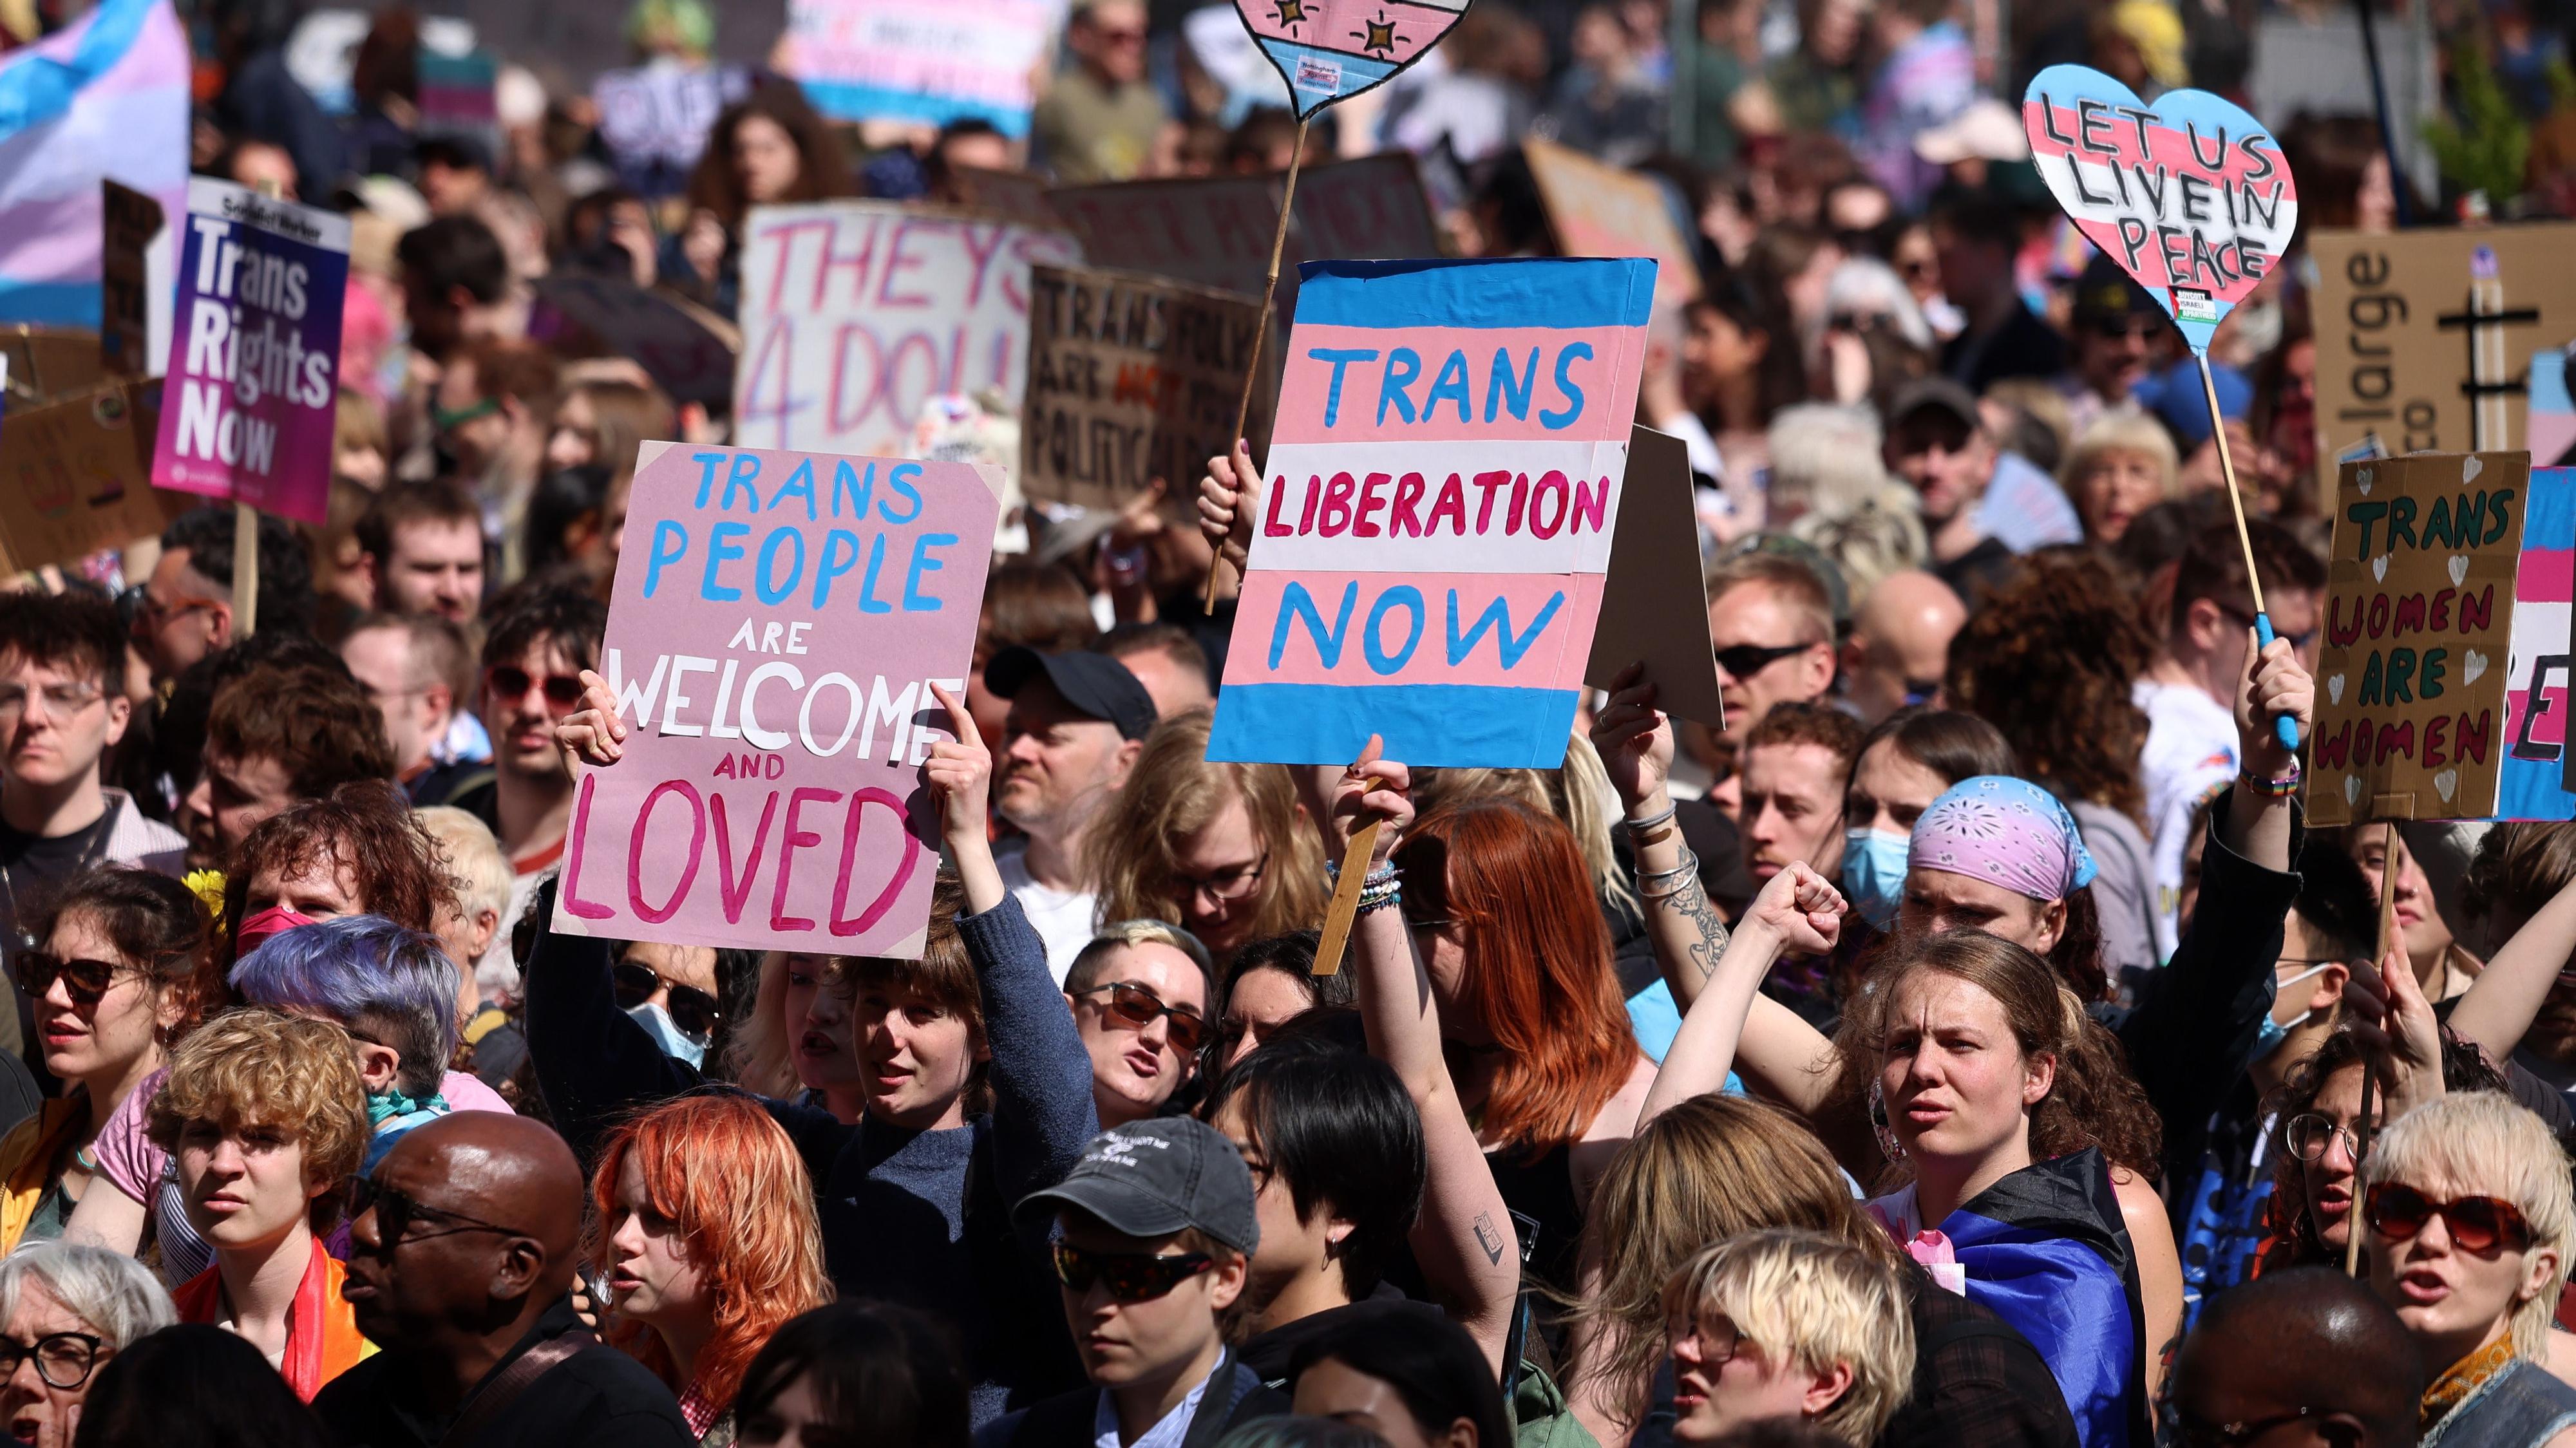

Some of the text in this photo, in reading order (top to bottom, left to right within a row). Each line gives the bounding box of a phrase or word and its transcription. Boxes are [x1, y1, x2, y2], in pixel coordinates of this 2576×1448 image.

[2041, 92, 2275, 182] LET US
[2065, 151, 2284, 231] LIVE IN
[193, 216, 310, 321] Trans
[2117, 216, 2267, 289] PEACE
[1034, 276, 1167, 350] TRANS
[2177, 290, 2206, 301] BOYCOTT
[2180, 301, 2204, 309] ISRAELI
[2182, 309, 2217, 320] APARTHEID
[185, 298, 333, 410] Rights
[734, 315, 815, 451] 4
[1038, 348, 1101, 402] ARE
[1114, 362, 1184, 417] NOT
[1307, 341, 1595, 431] TRANS
[175, 381, 278, 477] Now
[692, 453, 924, 525] TRANS
[1263, 469, 1610, 540] LIBERATION
[2347, 489, 2515, 562] TRANS
[643, 519, 960, 614] PEOPLE
[727, 616, 813, 655] ARE
[1267, 579, 1566, 676] NOW
[2328, 583, 2494, 647] WOMEN
[607, 648, 965, 769] WELCOME
[2358, 648, 2448, 708] ARE
[713, 752, 786, 782] AND
[2315, 708, 2491, 771] WOMEN
[563, 772, 920, 937] LOVED
